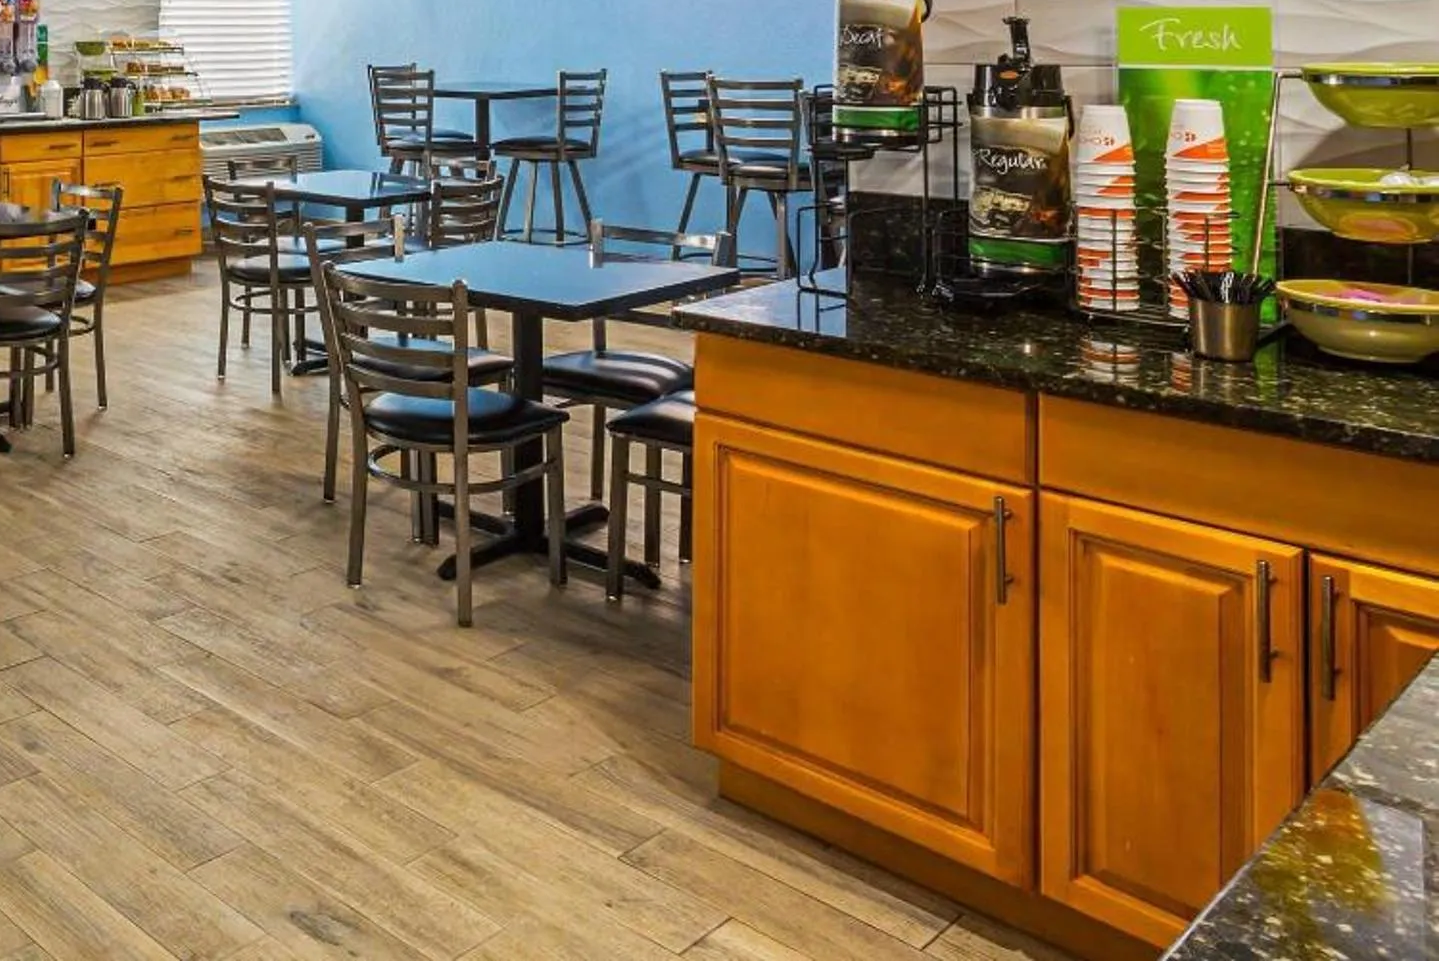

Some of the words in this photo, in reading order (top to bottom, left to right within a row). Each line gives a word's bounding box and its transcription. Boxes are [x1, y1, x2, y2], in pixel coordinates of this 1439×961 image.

[841, 24, 884, 48] Decaf
[1138, 17, 1243, 52] Fresh
[974, 148, 1046, 175] Regular
